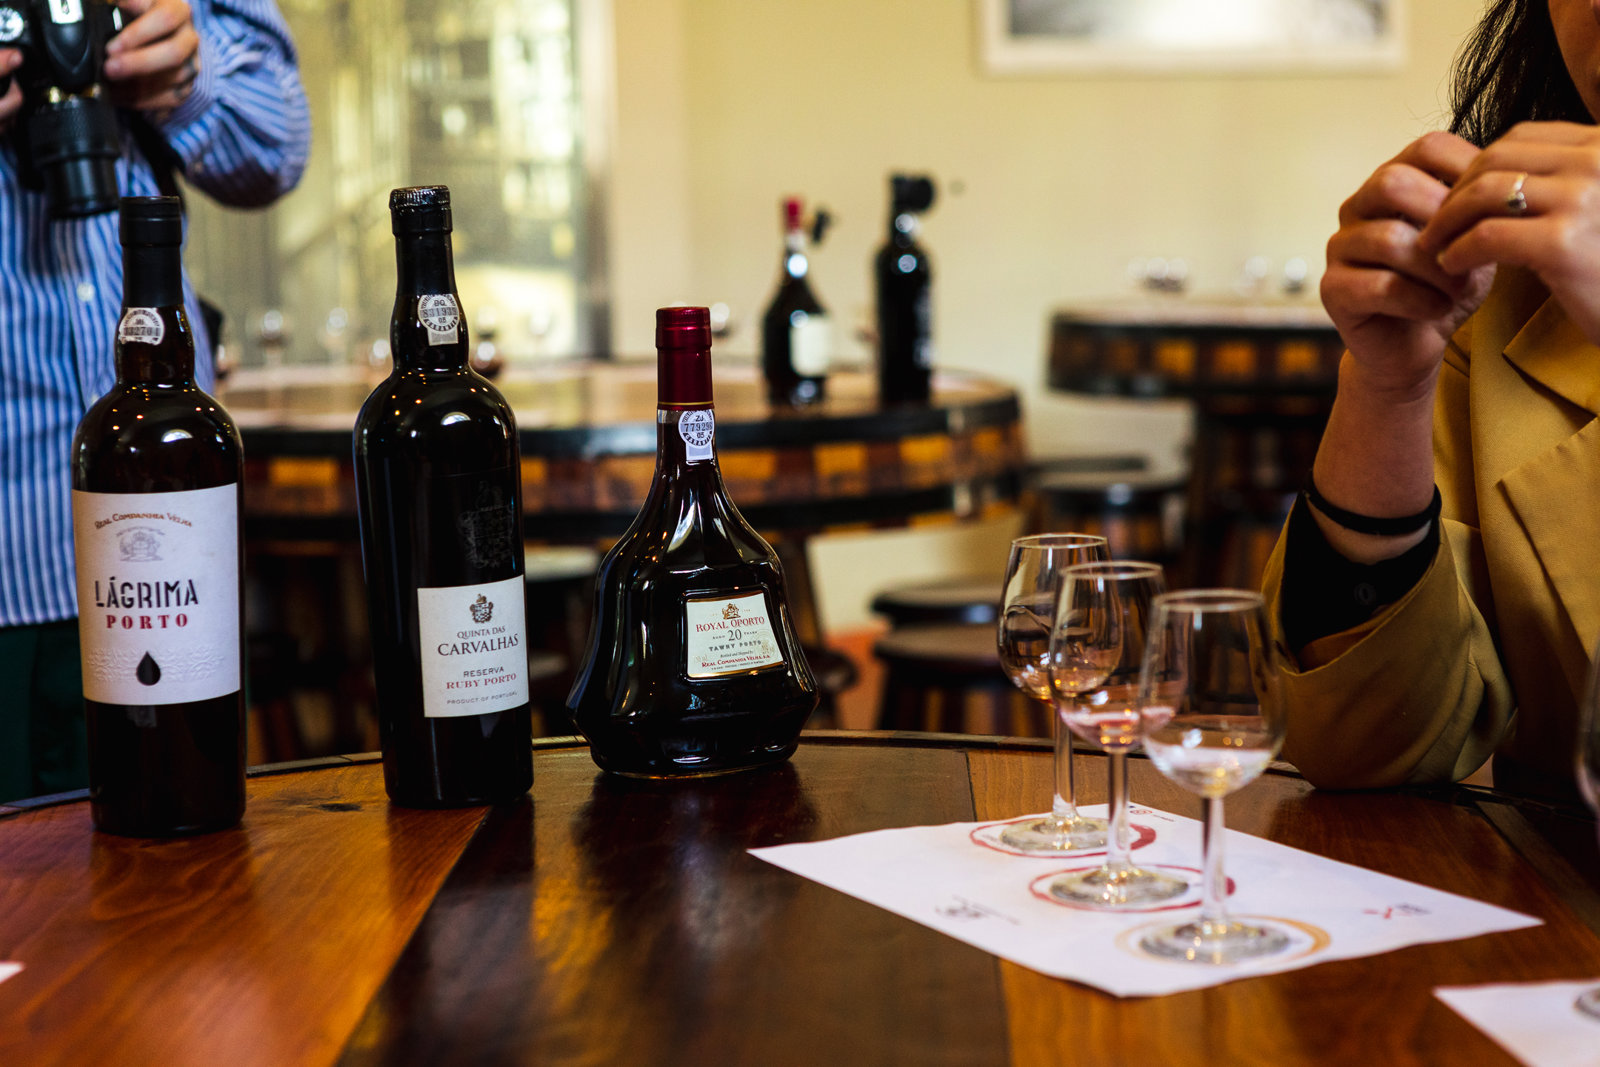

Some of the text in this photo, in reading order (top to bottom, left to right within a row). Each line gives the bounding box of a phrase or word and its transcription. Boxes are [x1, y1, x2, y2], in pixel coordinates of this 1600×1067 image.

[94, 518, 112, 530] REAL
[95, 576, 199, 609] LÁGRIMA
[106, 613, 188, 629] PORTO
[696, 616, 765, 632] ROYAL OPORTO
[456, 626, 506, 640] QUINTA DAS
[727, 628, 742, 642] 20
[437, 633, 520, 656] CARVALHAS
[740, 640, 762, 648] PORTO
[463, 666, 505, 678] RESERVA
[446, 672, 517, 689] RUBY PORTO
[490, 691, 518, 700] PORTUGAL
